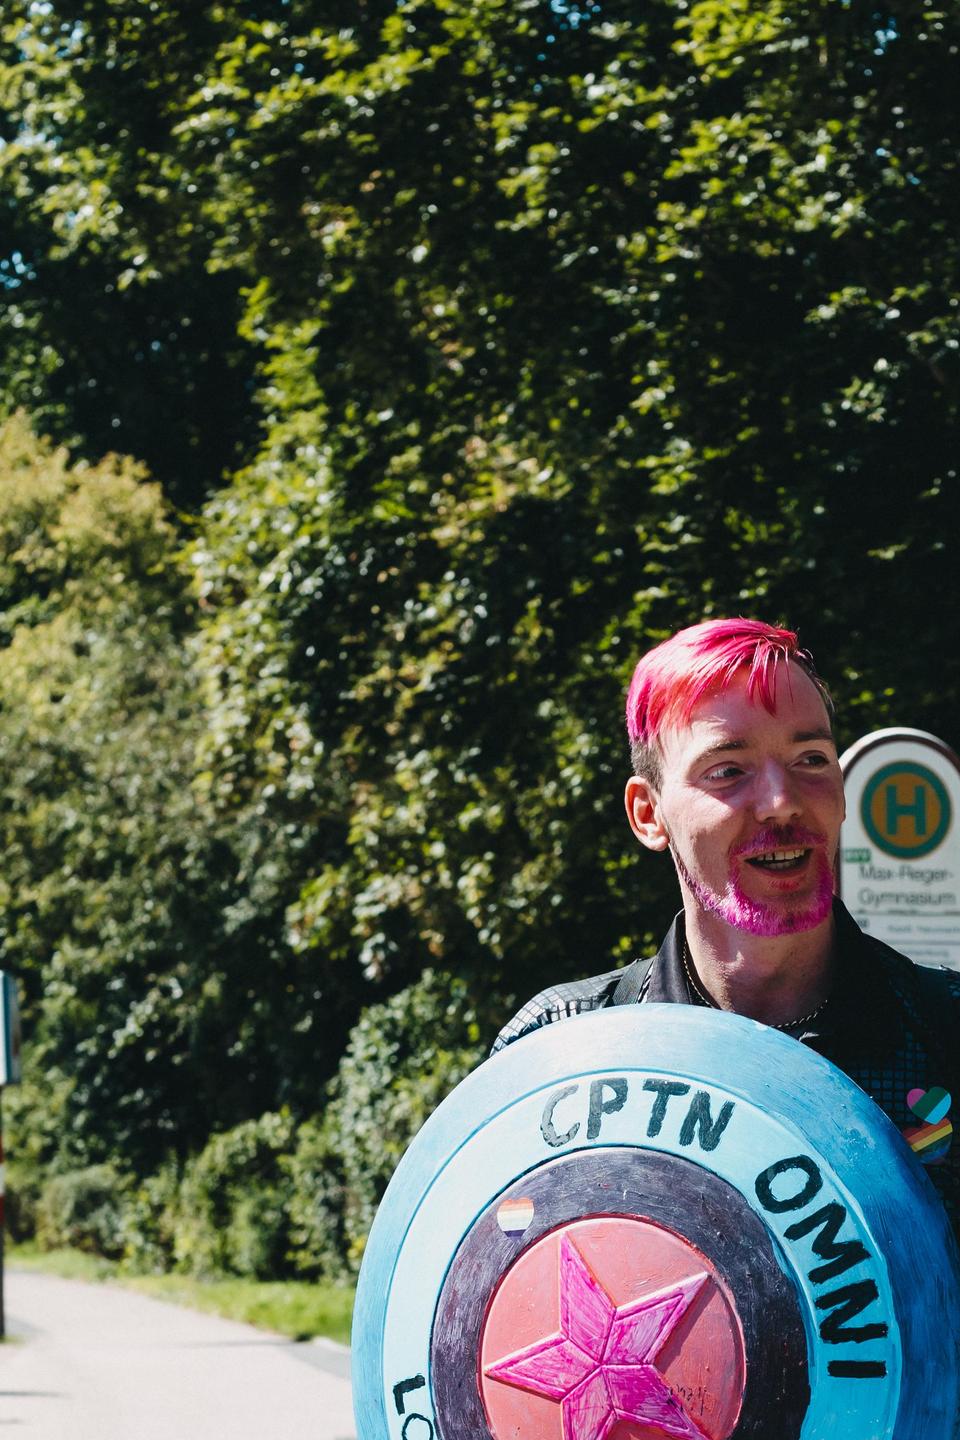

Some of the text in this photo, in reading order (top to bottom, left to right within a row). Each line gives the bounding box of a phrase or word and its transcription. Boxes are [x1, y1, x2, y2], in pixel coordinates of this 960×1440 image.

[886, 784, 926, 836] H
[858, 888, 957, 907] Gymnasium
[541, 1078, 889, 1379] CPTN OMNI
